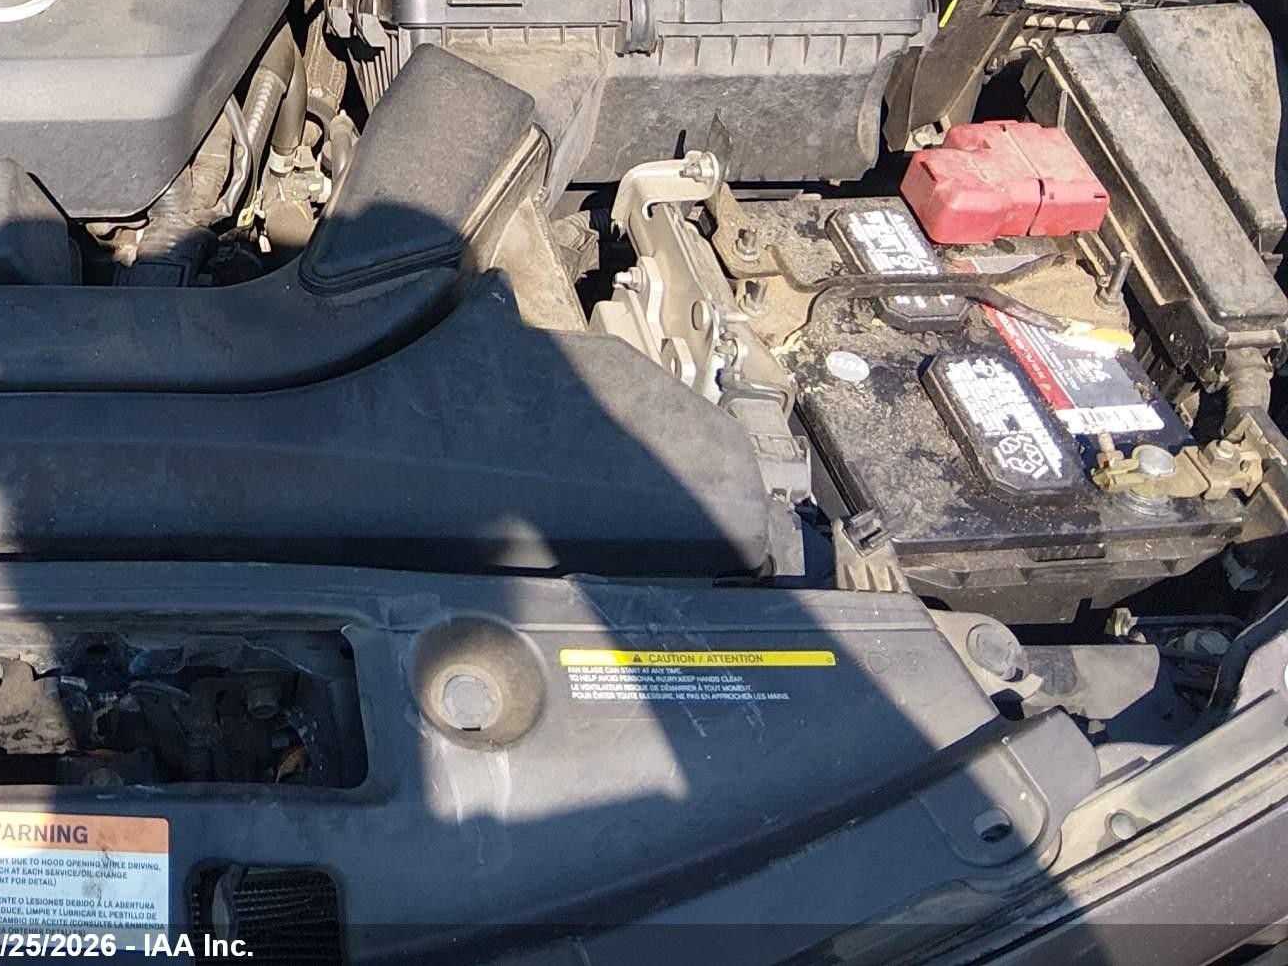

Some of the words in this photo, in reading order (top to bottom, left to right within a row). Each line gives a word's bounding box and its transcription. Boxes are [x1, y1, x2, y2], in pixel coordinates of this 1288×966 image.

[649, 654, 694, 663] CAUTION
[707, 654, 764, 663] ATTENTION
[650, 684, 659, 692] DE
[42, 858, 64, 866] HOOD
[66, 860, 101, 868] OPENING
[22, 868, 43, 876] EACH
[46, 868, 94, 878] SERVICE/OIL
[96, 870, 128, 879] CHANGE
[28, 878, 57, 886] DETAIL)
[26, 898, 64, 906] LESIONES
[66, 899, 94, 907] DEBIDO
[104, 900, 113, 908] LA
[114, 901, 155, 910] ABERTURA
[26, 907, 50, 916] LIMPIE
[52, 908, 57, 916] Y
[59, 908, 97, 918] LUBRICAR
[98, 910, 107, 918] EL
[108, 910, 145, 920] PESTILLO
[146, 912, 157, 920] DE
[29, 918, 40, 926] DE
[41, 918, 68, 926] ACEITE
[69, 918, 113, 928] (CONSULTE
[114, 921, 124, 929] LA
[125, 922, 165, 930] ENMIENDA
